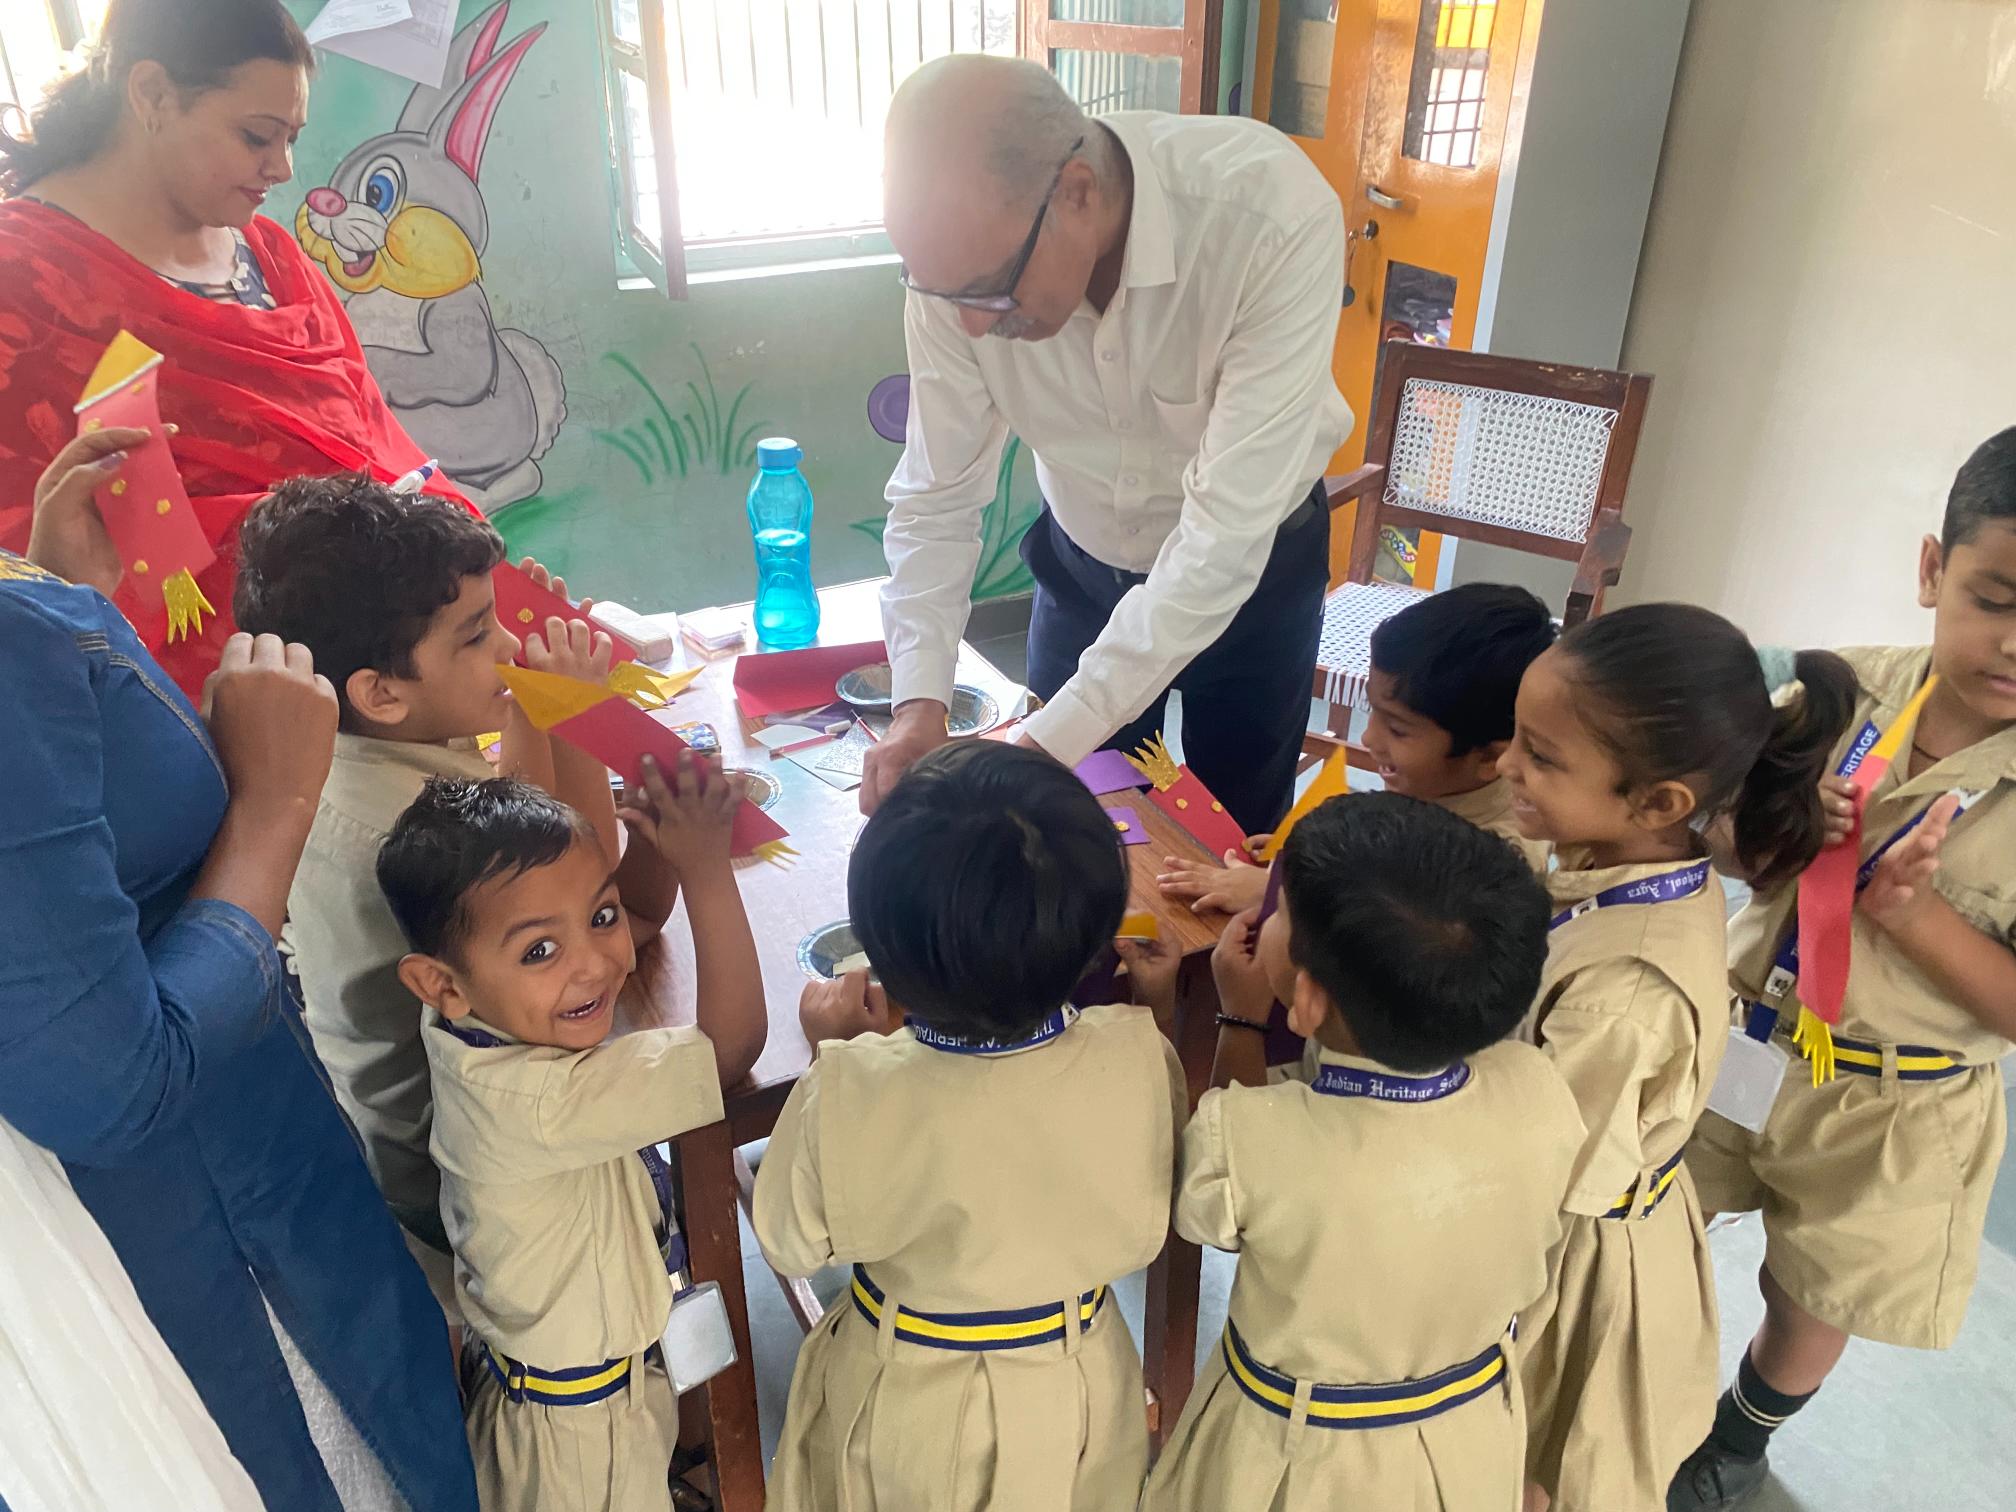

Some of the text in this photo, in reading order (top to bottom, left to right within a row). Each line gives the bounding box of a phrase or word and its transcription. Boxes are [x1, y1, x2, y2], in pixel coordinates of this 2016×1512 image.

[1841, 728, 1878, 779] ERITAGE
[1627, 879, 1661, 899] Agra
[913, 1024, 968, 1048] HERITAG
[1326, 1072, 1363, 1094] Indian
[1368, 1078, 1434, 1102] Heritage
